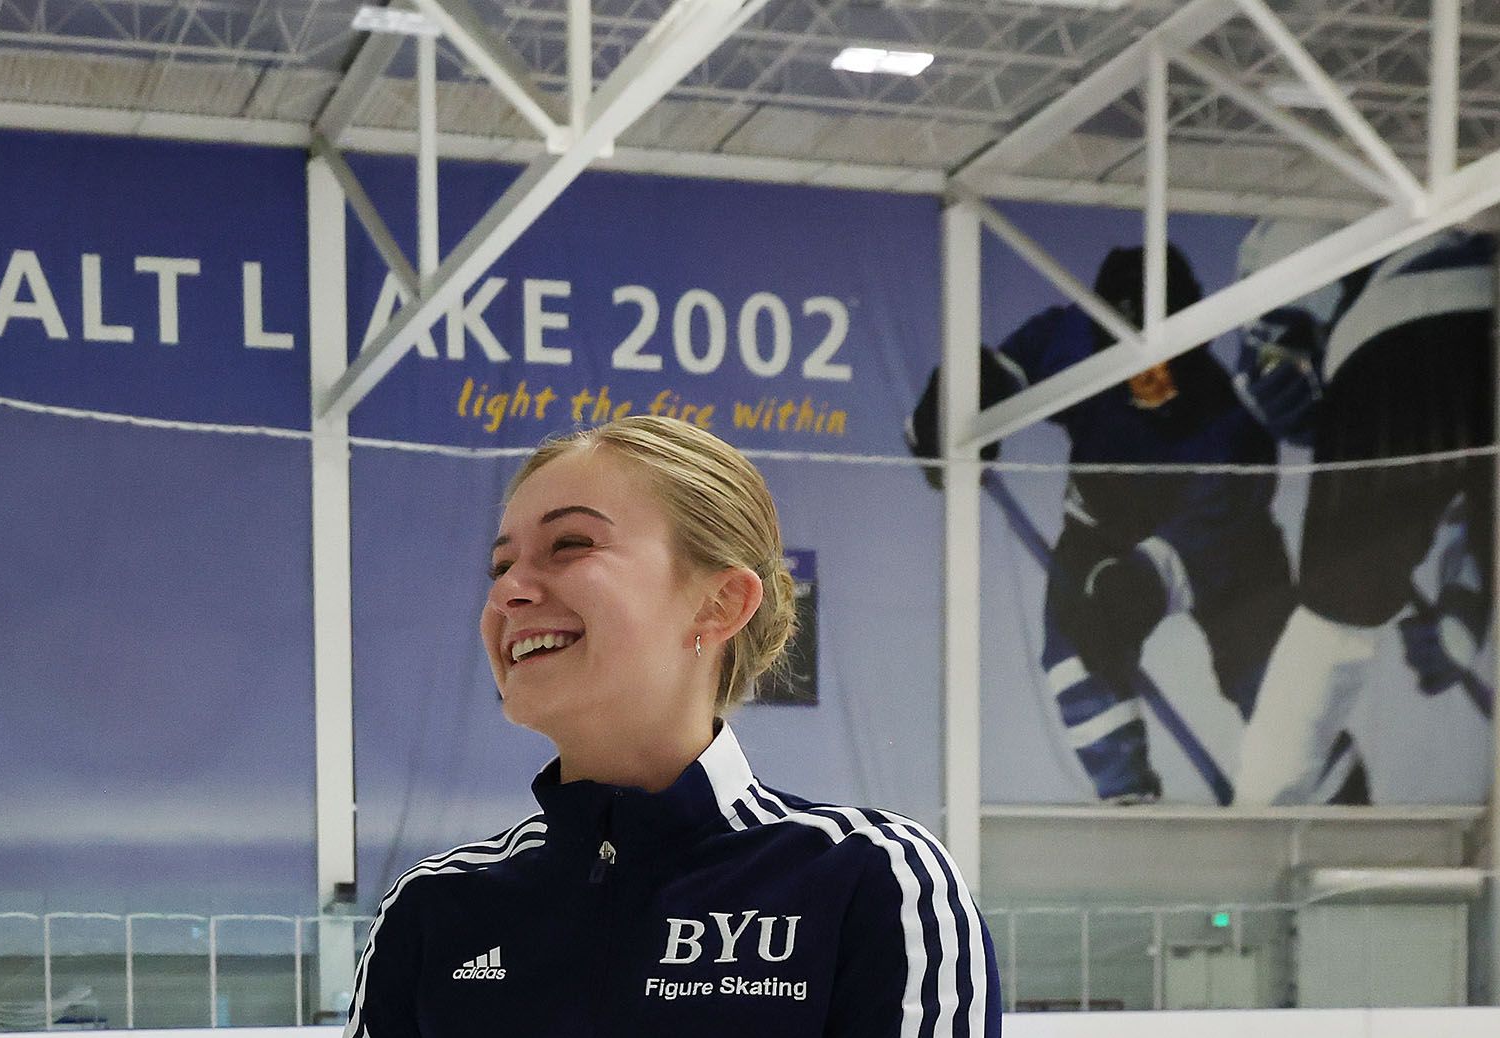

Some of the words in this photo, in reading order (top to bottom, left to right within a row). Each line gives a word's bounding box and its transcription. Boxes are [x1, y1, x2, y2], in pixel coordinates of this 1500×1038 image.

[242, 261, 573, 366] LAKE
[611, 284, 853, 383] 2002
[457, 376, 557, 433] light
[571, 385, 633, 424] the
[733, 394, 847, 437] within
[659, 910, 802, 965] BYU
[452, 966, 507, 980] adidas
[645, 977, 714, 1001] Figure
[719, 976, 807, 1001] Skating
